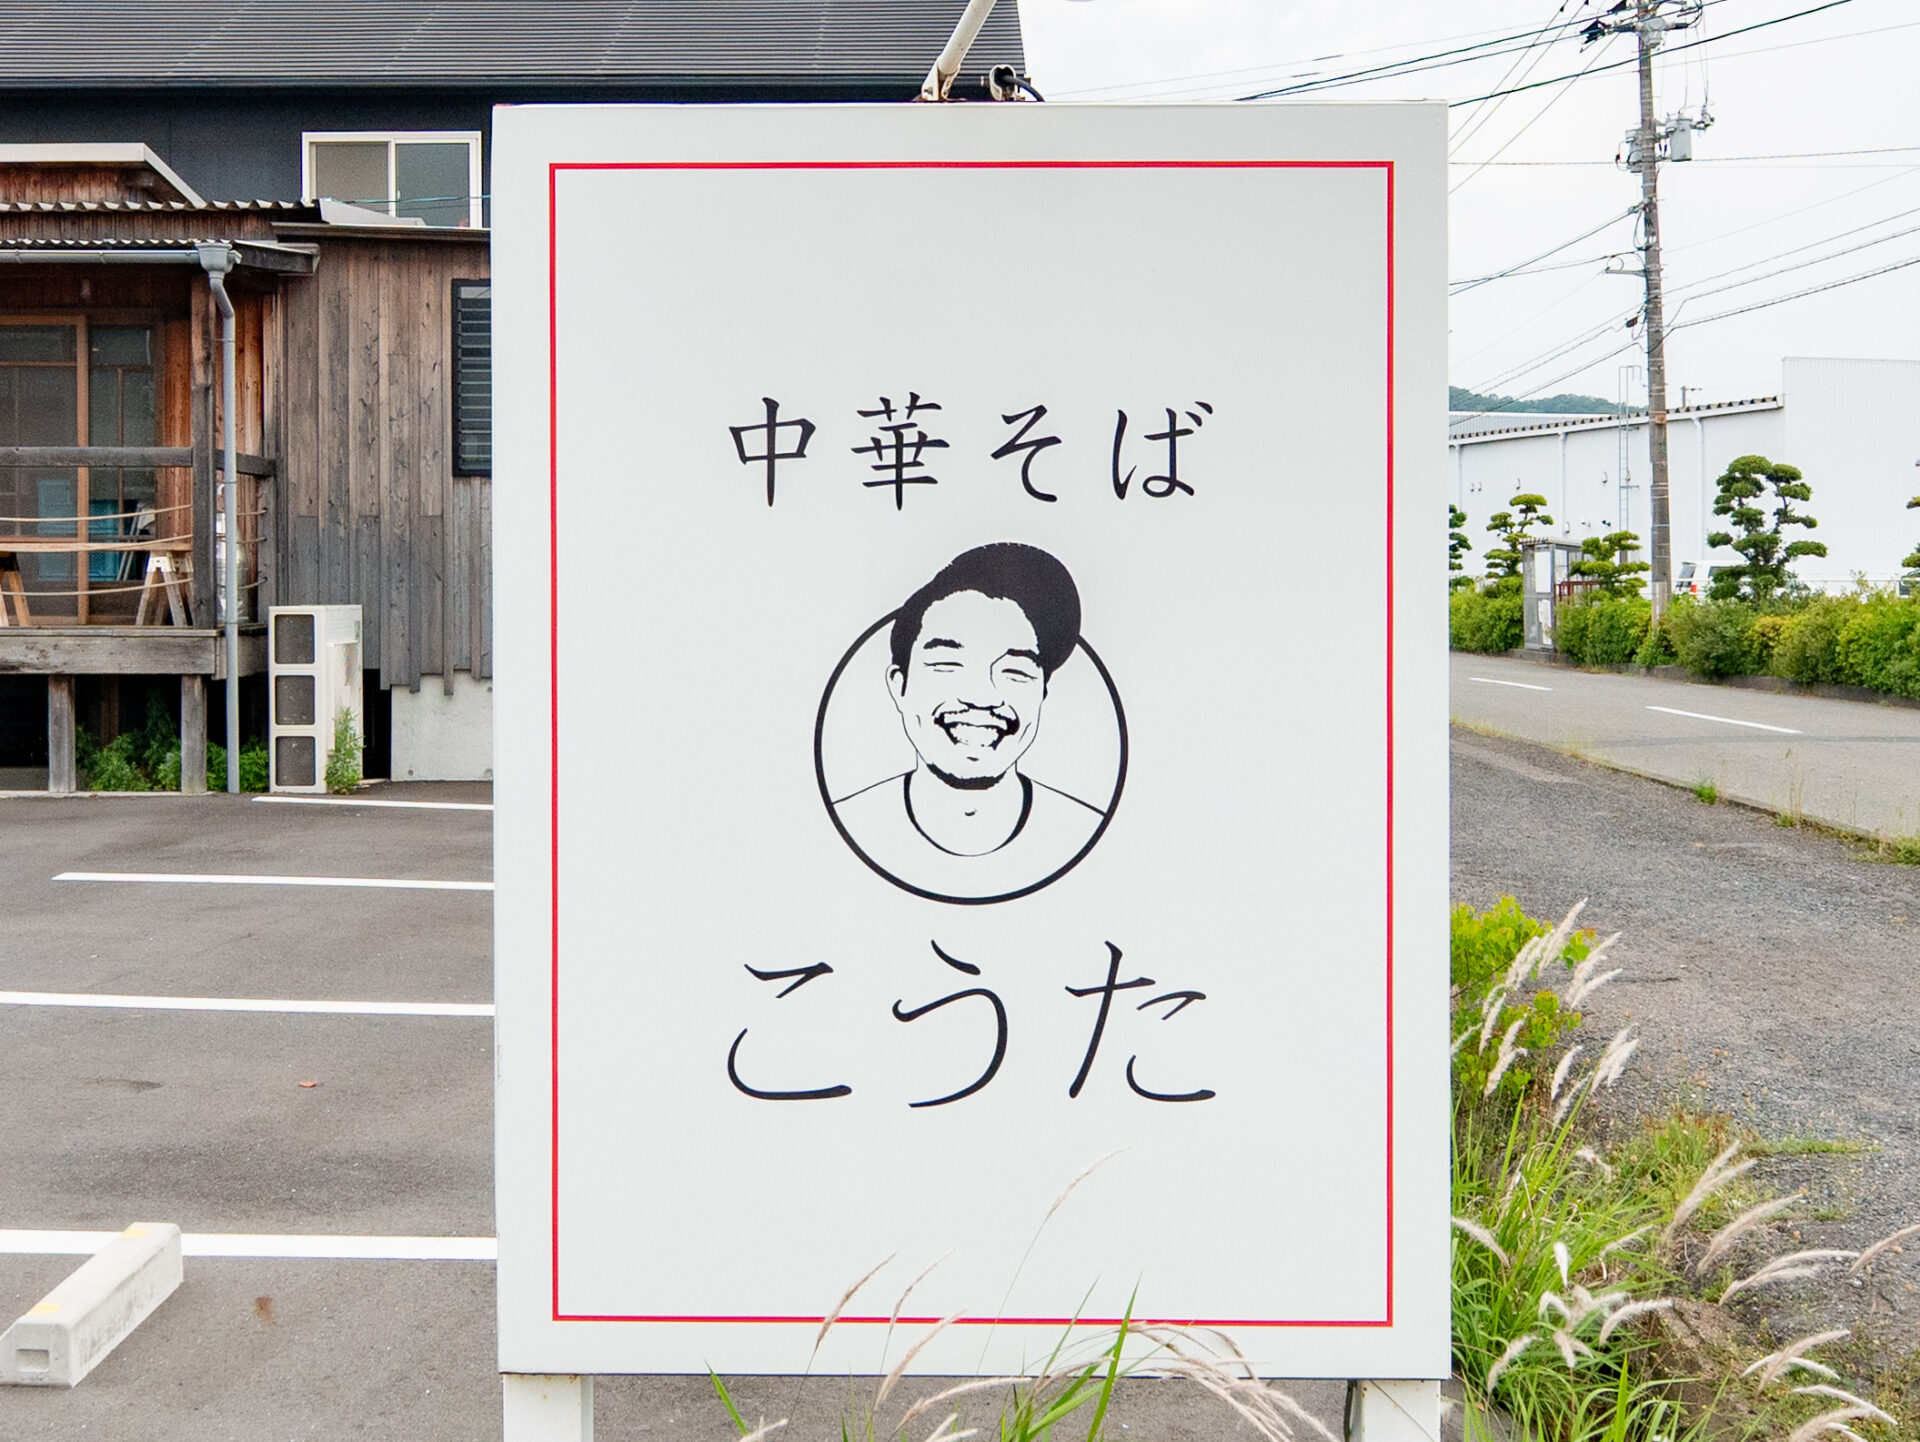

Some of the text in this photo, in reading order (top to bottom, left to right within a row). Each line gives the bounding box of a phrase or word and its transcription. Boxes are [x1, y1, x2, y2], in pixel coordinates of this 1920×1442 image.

[728, 391, 1213, 511] 中華そば
[727, 939, 1216, 1108] こうた
